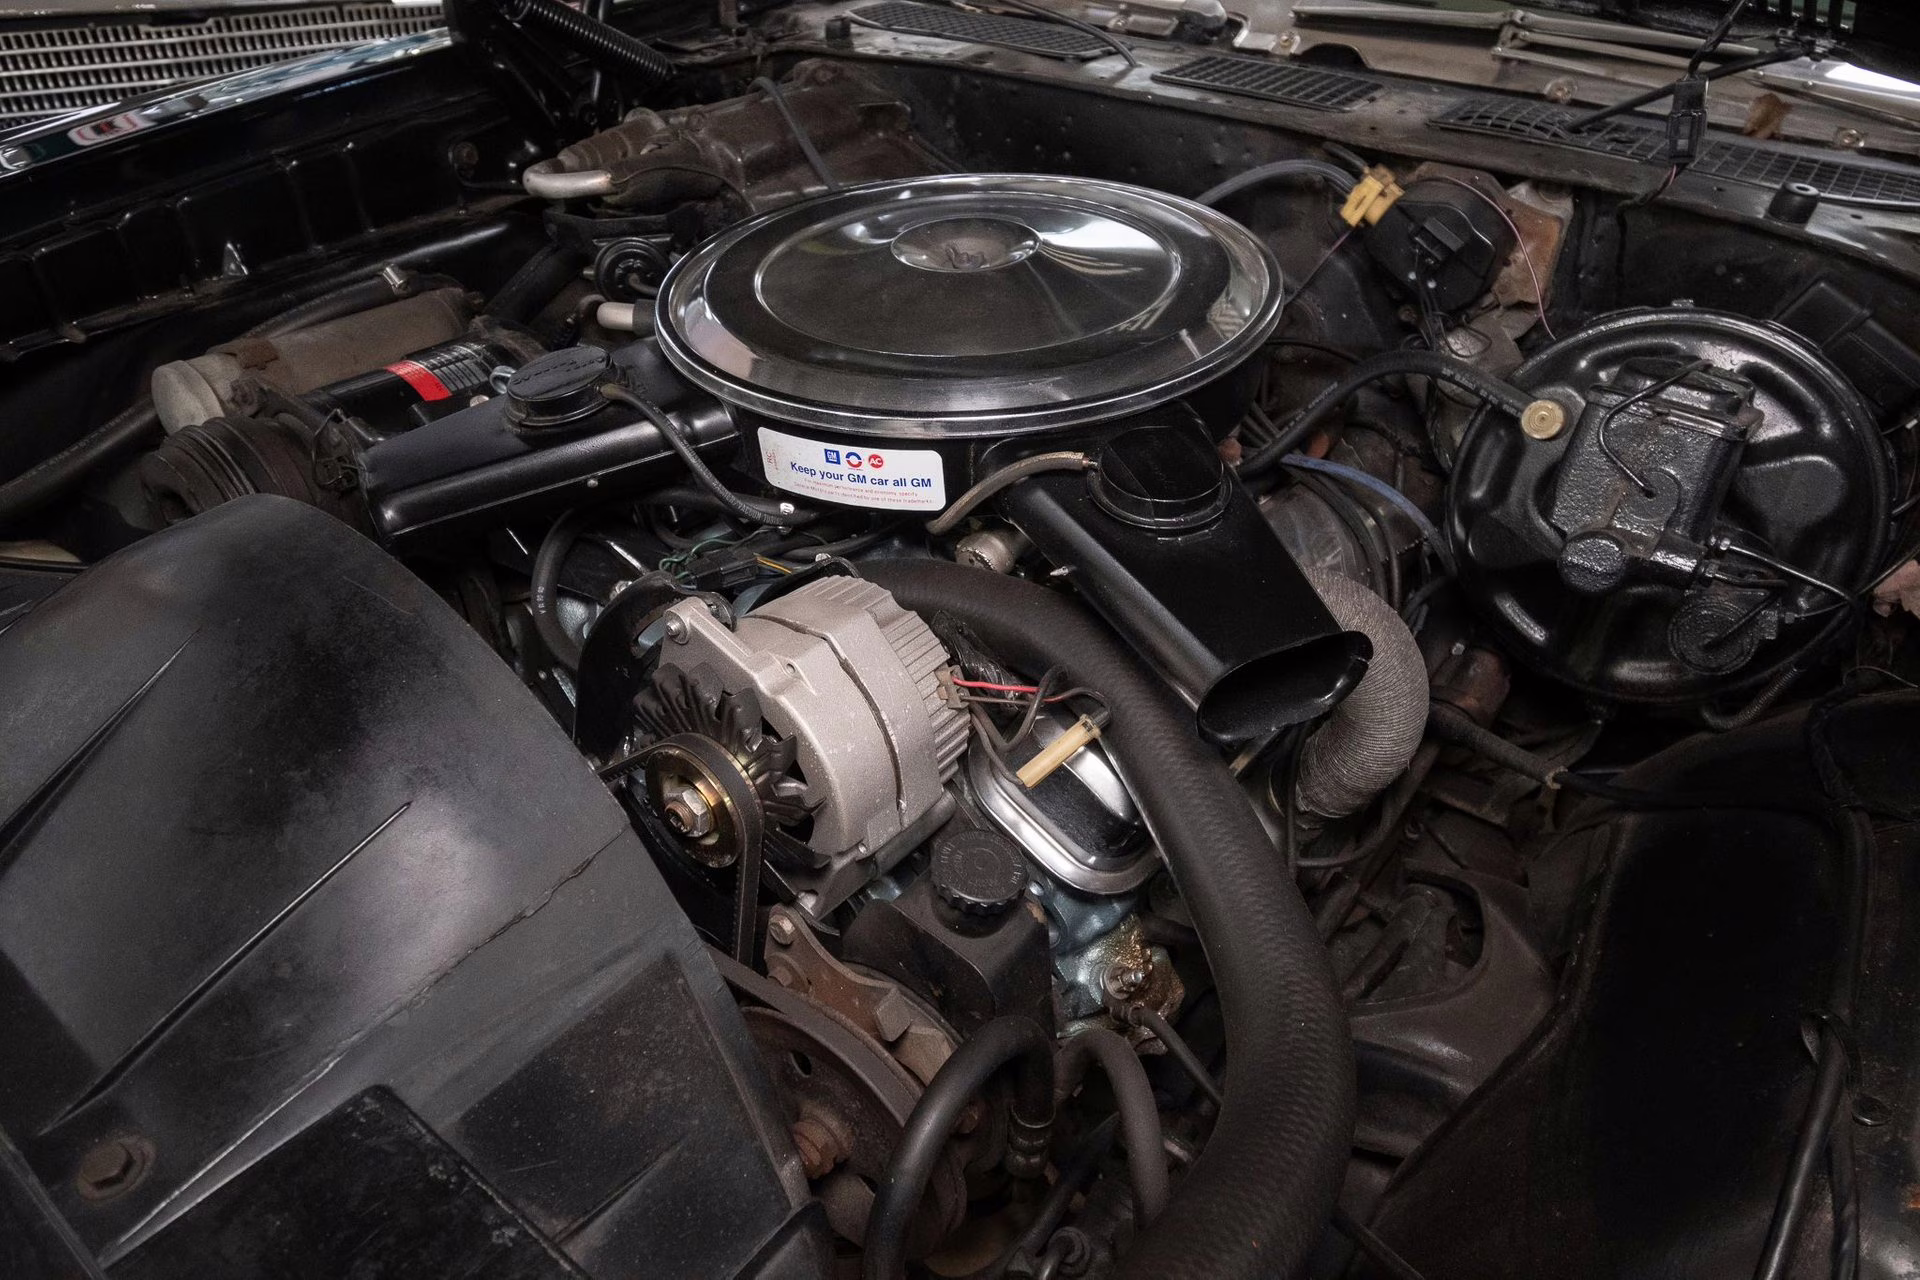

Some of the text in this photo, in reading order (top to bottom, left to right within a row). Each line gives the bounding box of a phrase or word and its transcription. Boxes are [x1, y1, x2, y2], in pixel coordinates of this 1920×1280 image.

[869, 455, 883, 467] AC
[791, 461, 932, 488] Keep your GM car all GM
